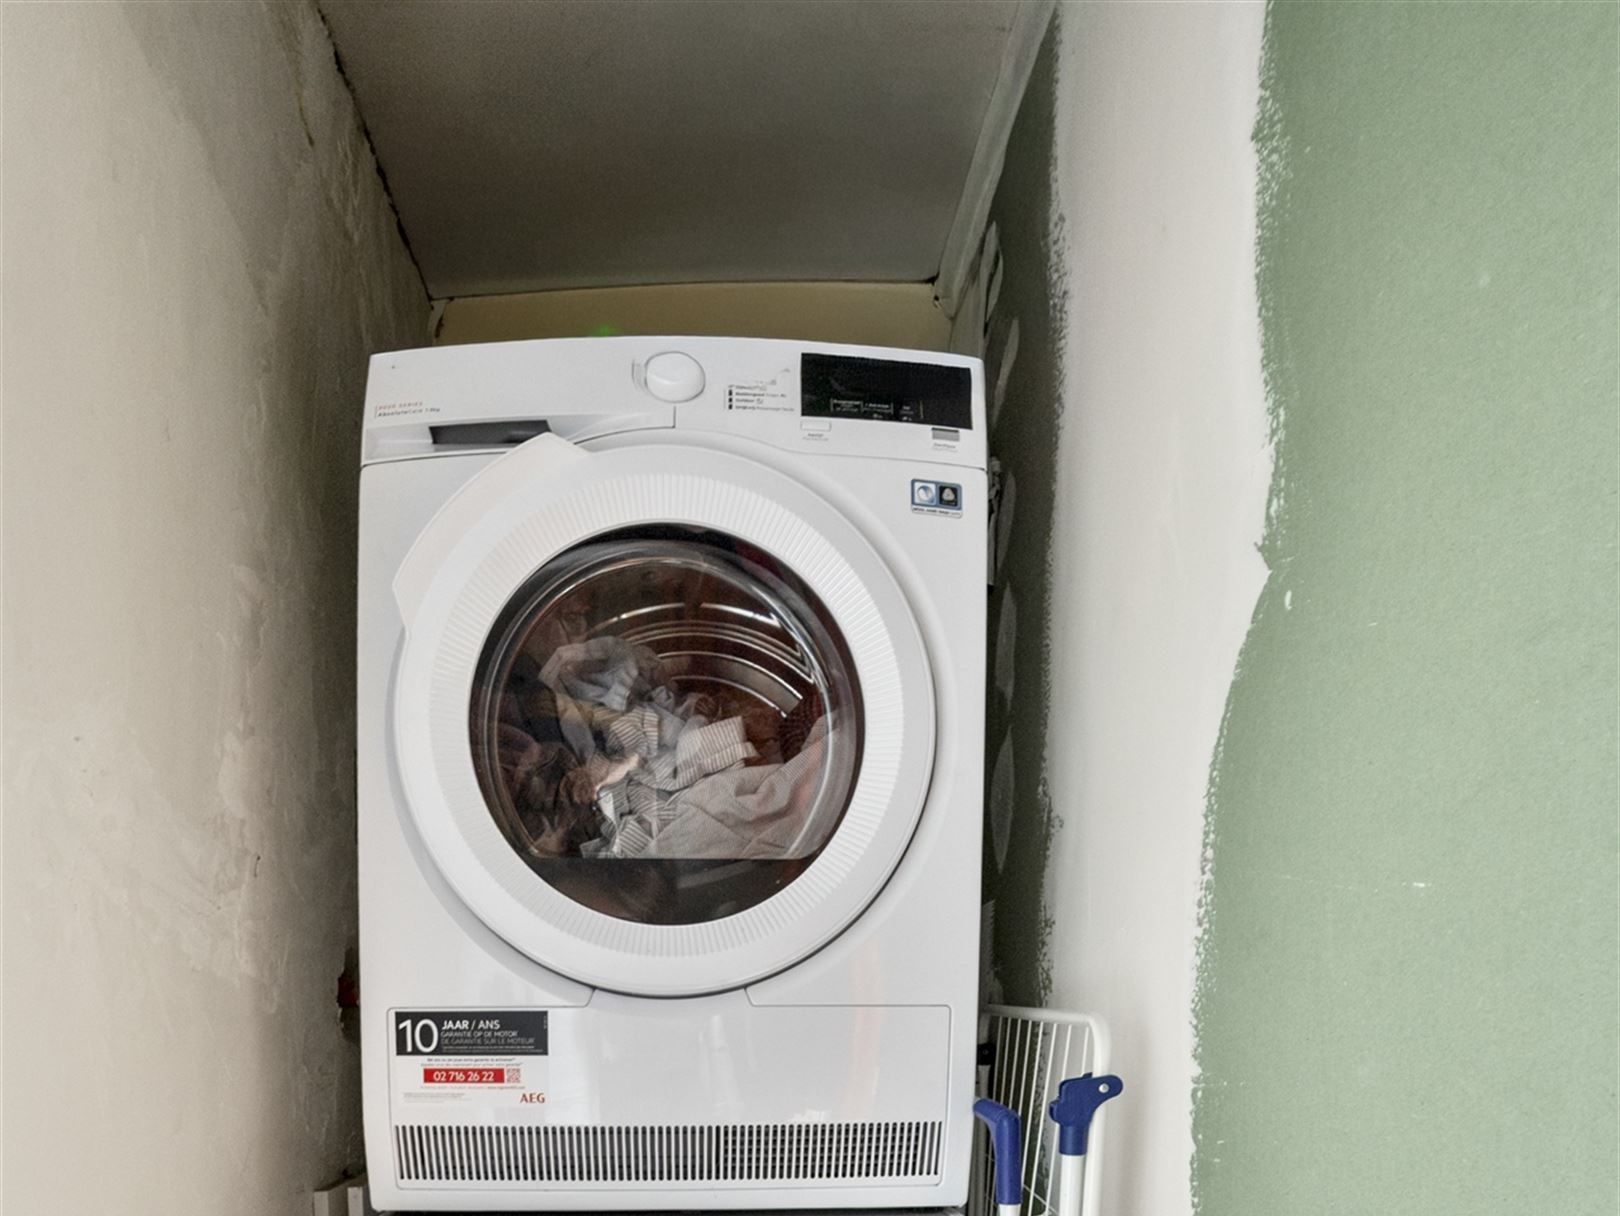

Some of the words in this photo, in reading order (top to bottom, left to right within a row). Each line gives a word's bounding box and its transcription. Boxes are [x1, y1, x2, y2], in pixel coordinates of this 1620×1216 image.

[442, 1020, 469, 1030] JAAR
[478, 1019, 500, 1030] ANS
[398, 1018, 438, 1052] 10
[433, 1071, 447, 1082] 02
[448, 1071, 465, 1082] 716
[467, 1071, 480, 1082] 26
[482, 1071, 494, 1082] 22
[520, 1092, 546, 1104] AEG
